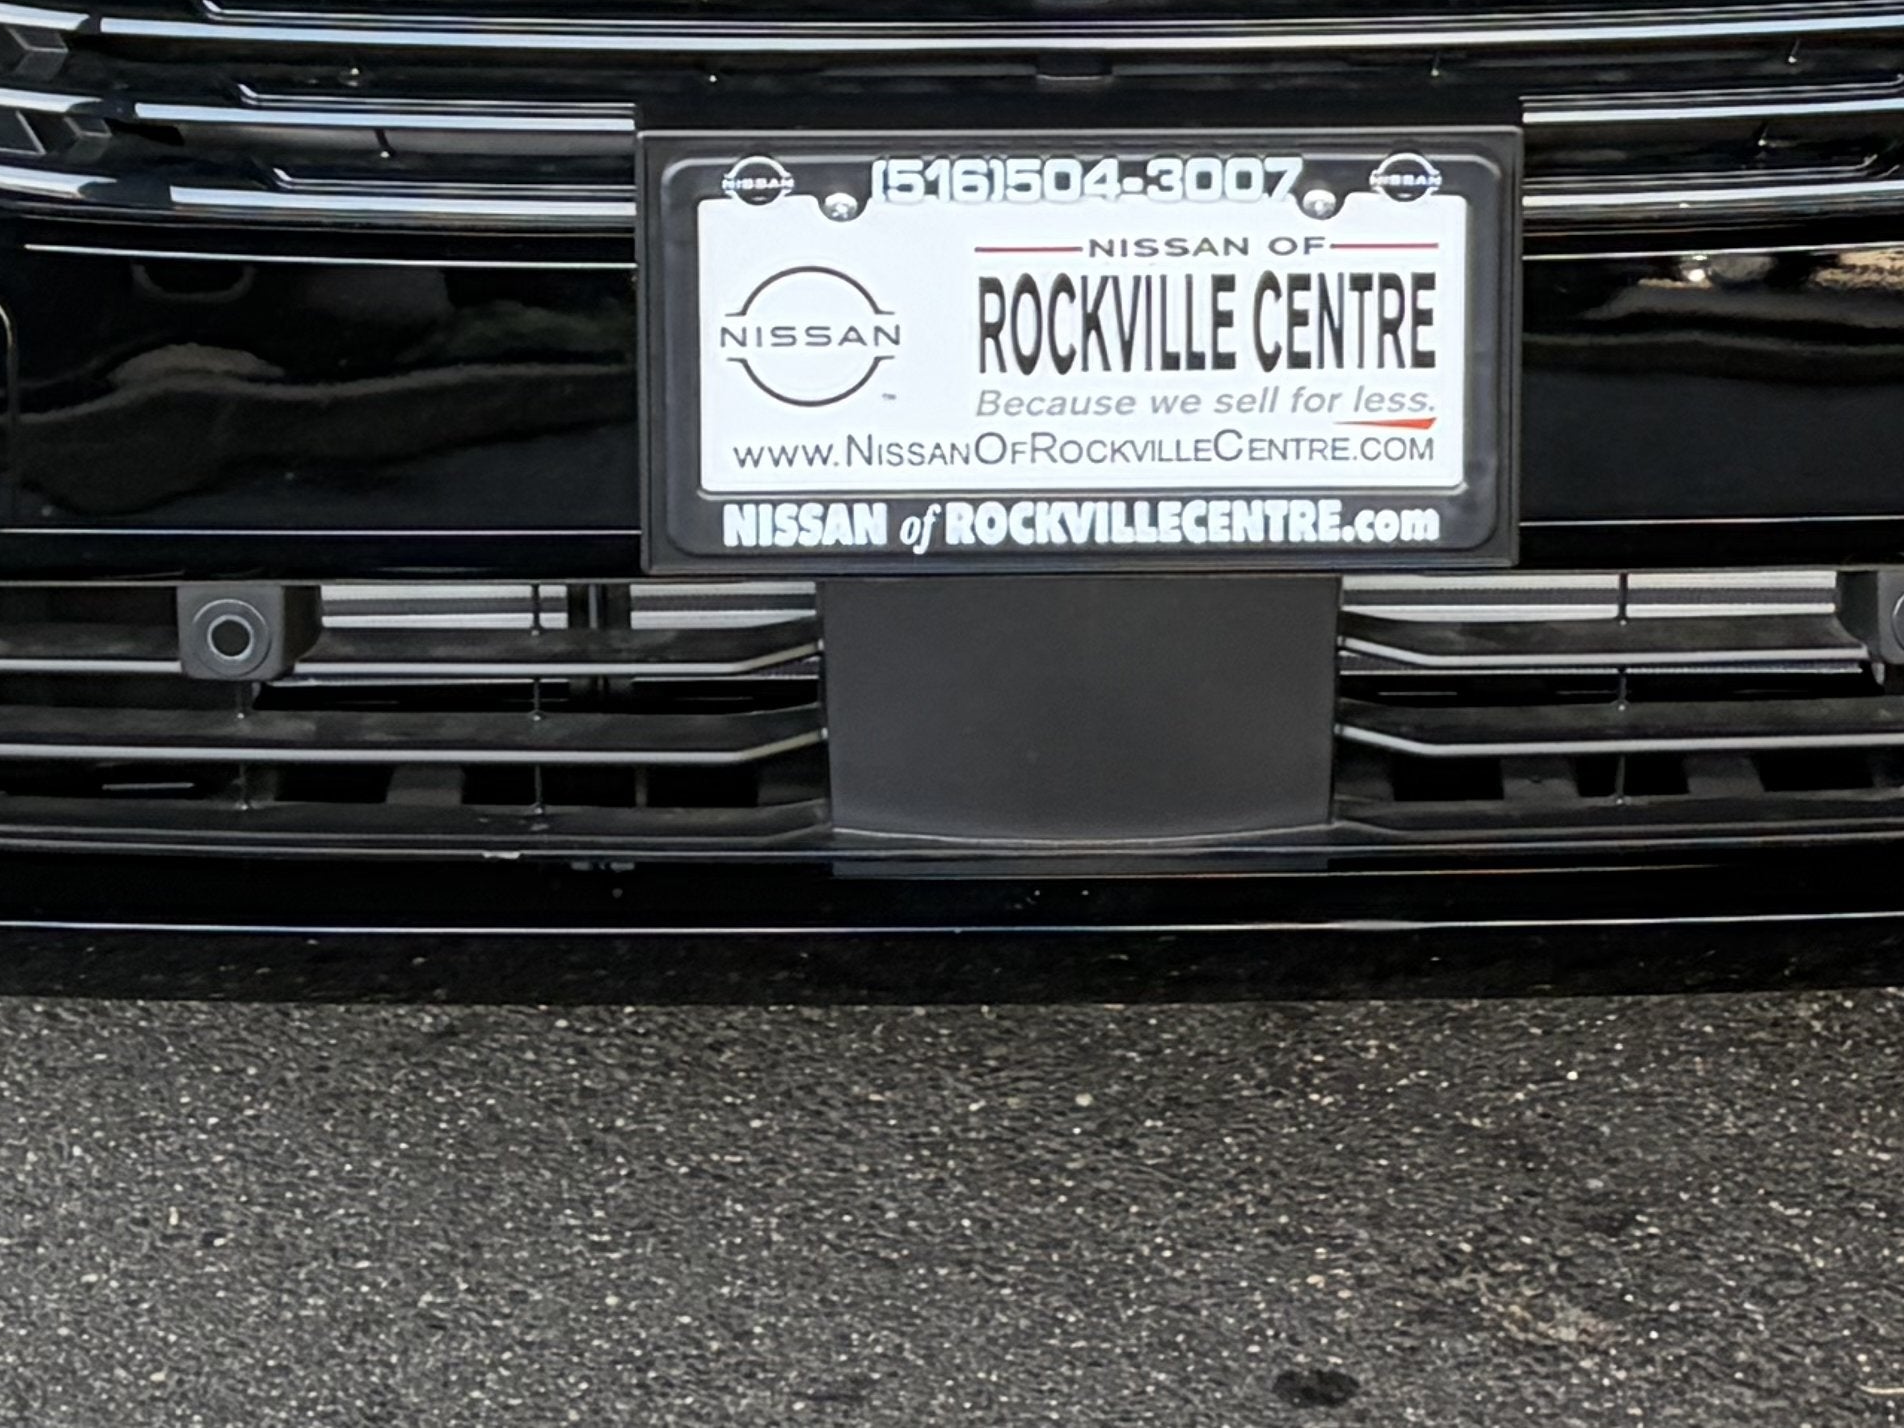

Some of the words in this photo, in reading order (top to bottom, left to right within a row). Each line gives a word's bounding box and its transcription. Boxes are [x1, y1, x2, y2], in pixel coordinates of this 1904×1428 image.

[872, 156, 1304, 204] (516)504-3007
[1088, 236, 1250, 258] NISSAN
[1267, 236, 1327, 256] OF
[720, 324, 901, 348] NISSAN
[978, 271, 1237, 376] ROCKVILLE
[1253, 270, 1437, 373] CENTRE
[975, 388, 1137, 418] Because
[1149, 394, 1203, 416] we
[1213, 386, 1280, 415] sell
[1287, 386, 1342, 414] for
[1353, 385, 1437, 413] less.
[722, 501, 889, 548] NISSAN
[899, 502, 942, 555] of
[945, 498, 1441, 545] ROCKVILLECENTRE.com
